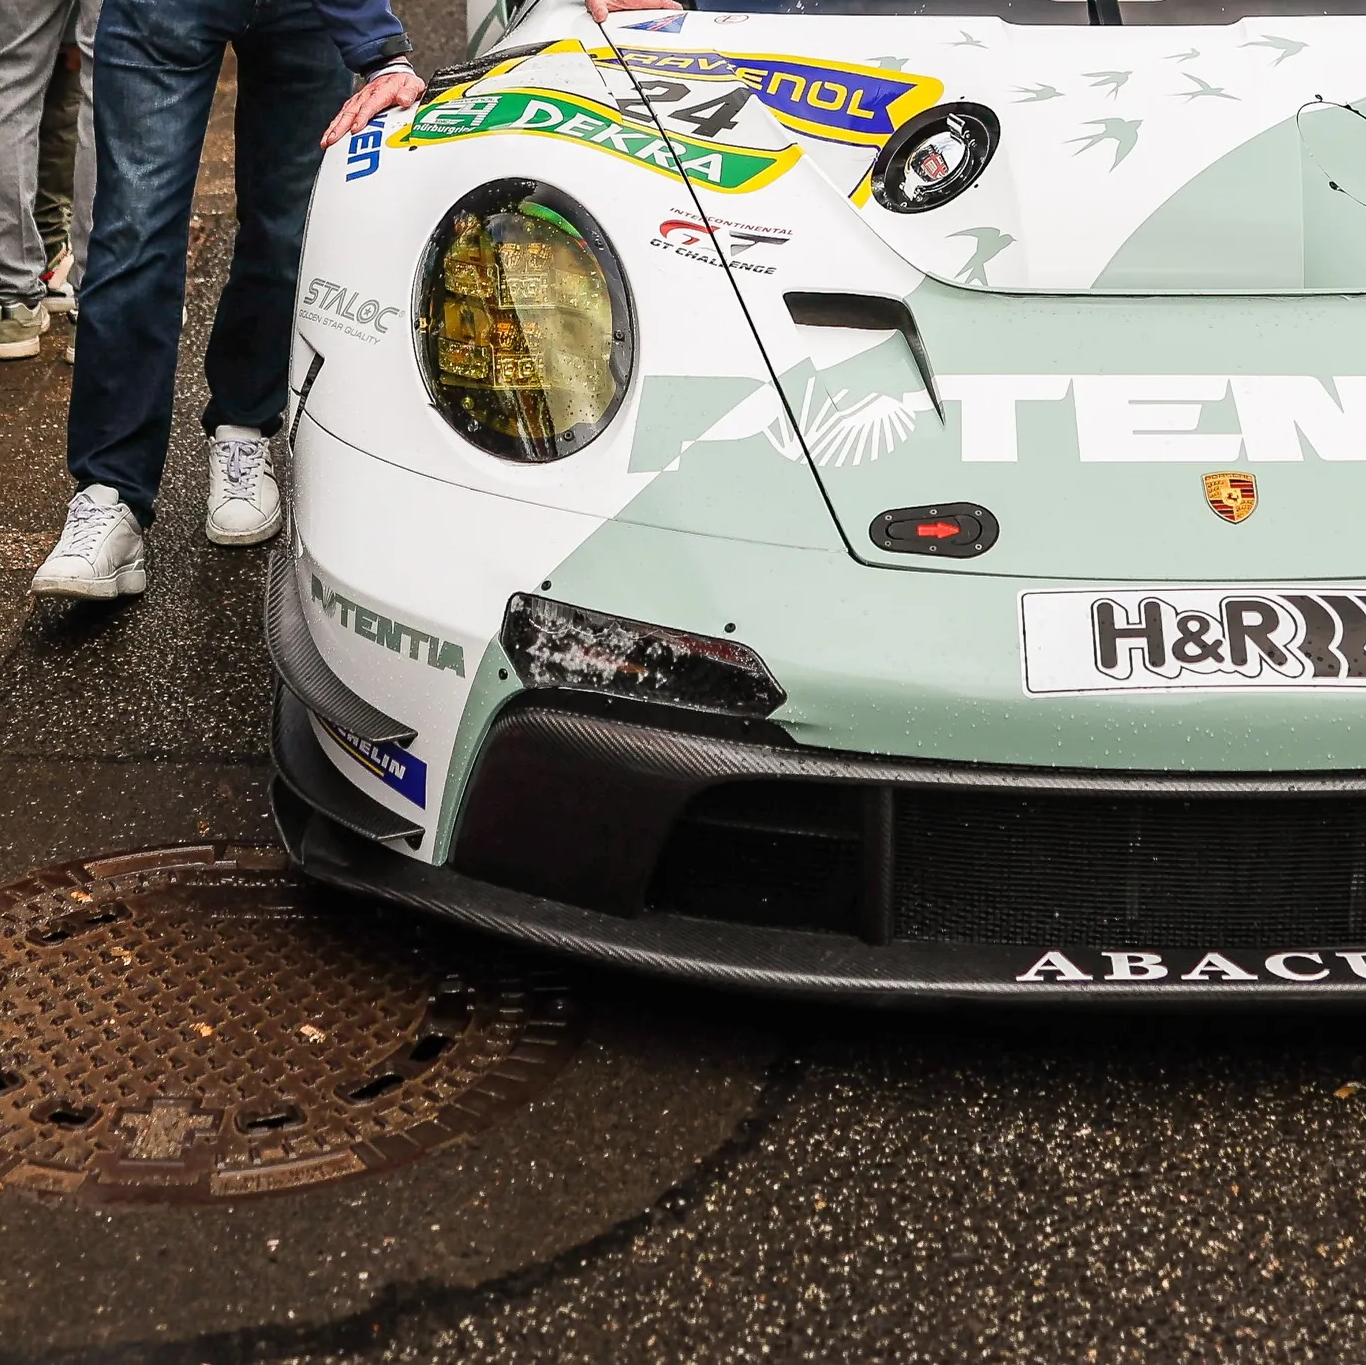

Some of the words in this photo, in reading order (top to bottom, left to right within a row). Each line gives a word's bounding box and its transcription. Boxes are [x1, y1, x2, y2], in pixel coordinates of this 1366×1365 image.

[617, 79, 751, 139] 24
[620, 51, 876, 120] RAVENOL
[513, 98, 724, 185] DEKRA
[669, 206, 793, 236] INTERCONTINENTAL
[650, 238, 674, 251] GT
[675, 245, 777, 276] CHALLENGE
[298, 308, 323, 324] GOLDEN
[322, 318, 344, 331] STAR
[343, 325, 381, 346] QUALITY
[302, 277, 401, 335] STALOC
[1090, 596, 1308, 681] H&R
